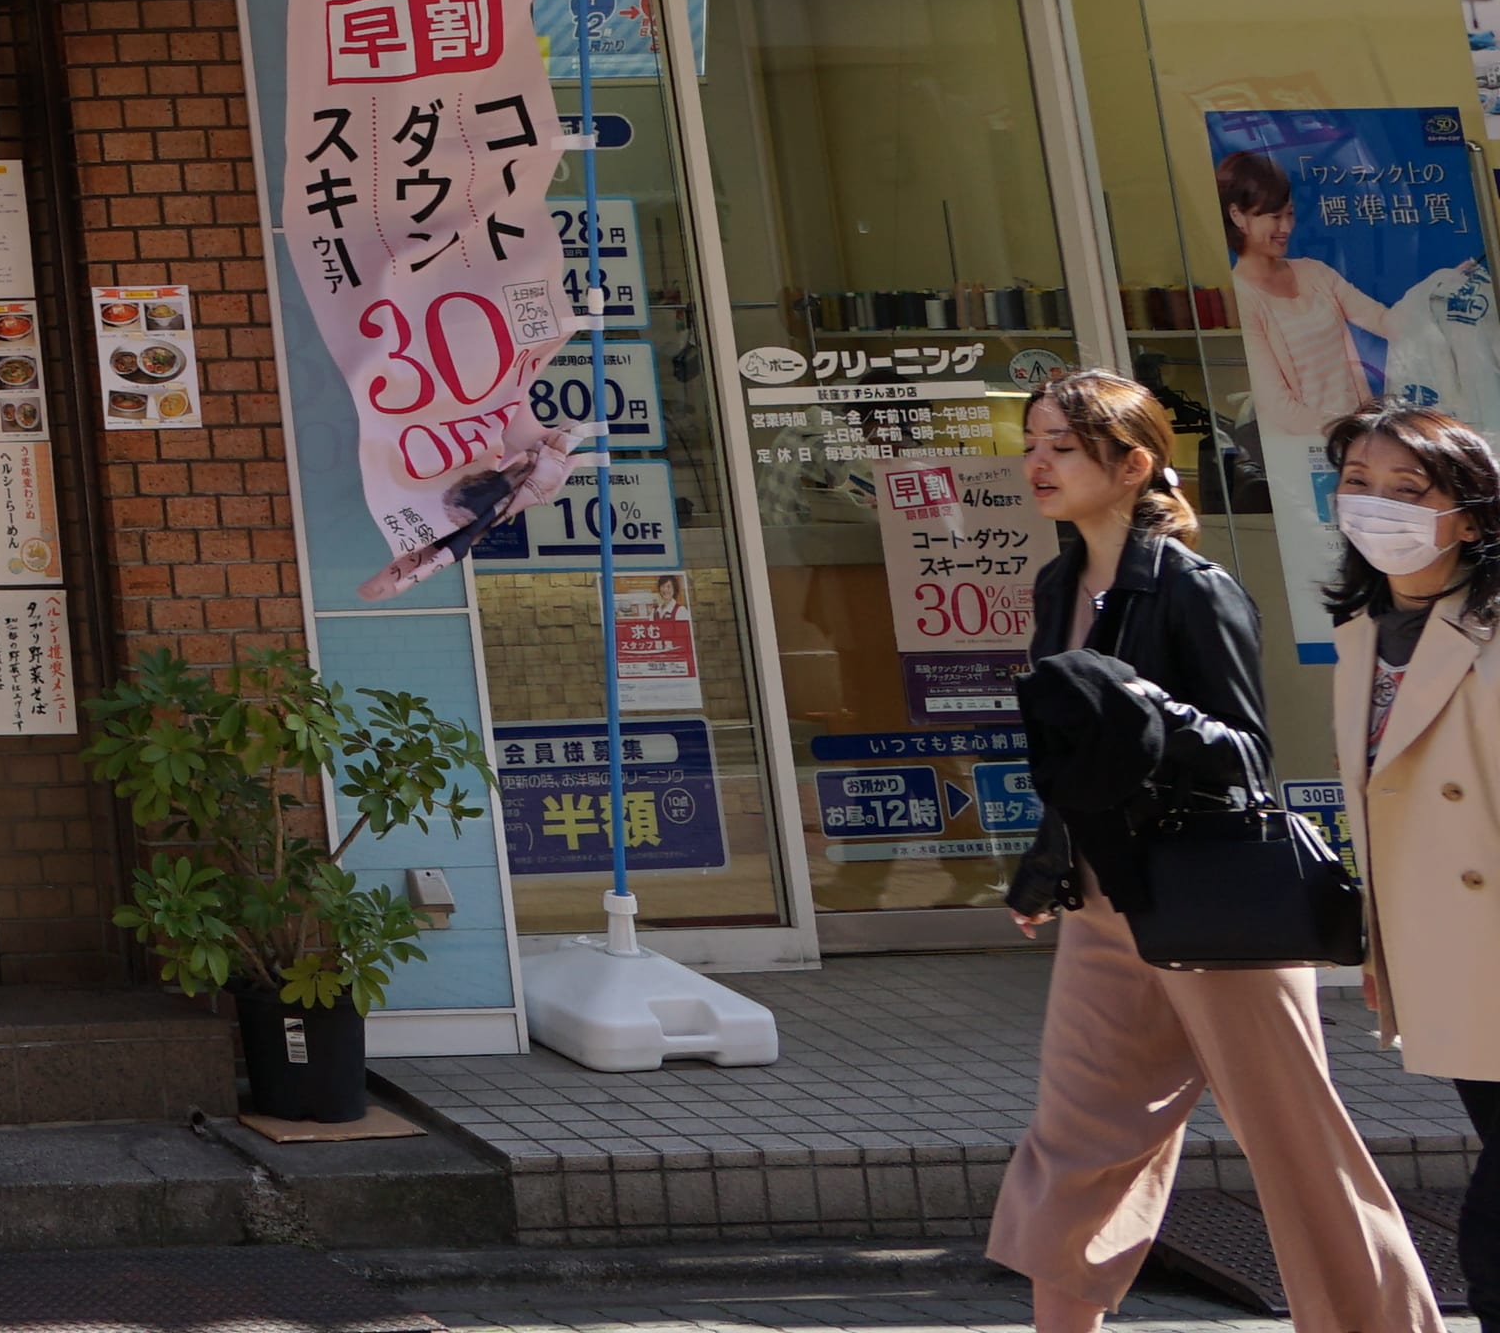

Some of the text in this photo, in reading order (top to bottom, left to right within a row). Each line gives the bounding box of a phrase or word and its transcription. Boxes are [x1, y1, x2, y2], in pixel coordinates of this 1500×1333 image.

[305, 108, 362, 288] スキー
[393, 98, 460, 274] ダウン
[514, 301, 549, 322] 25%
[521, 319, 550, 339] OFF
[769, 342, 985, 379] ポニー クリーニング
[751, 411, 807, 430] 営業時間
[825, 444, 894, 462] 毎週木曜日
[894, 472, 952, 504] 早割
[0, 452, 20, 550] ヘルシーらーめん
[622, 522, 662, 540] OFF
[912, 528, 1029, 550] コート・ダウン
[919, 555, 1028, 577] スキーウェア
[630, 624, 661, 640] 求む
[989, 609, 1035, 636] OF
[26, 601, 47, 715] タップリ野菜そば
[45, 596, 68, 724] ヘルシー推奨メニュー
[504, 739, 645, 766] 会員様募集
[869, 733, 1028, 754] いつでも安心納期
[846, 779, 900, 794] お預かり
[826, 797, 938, 829] お昼の12時
